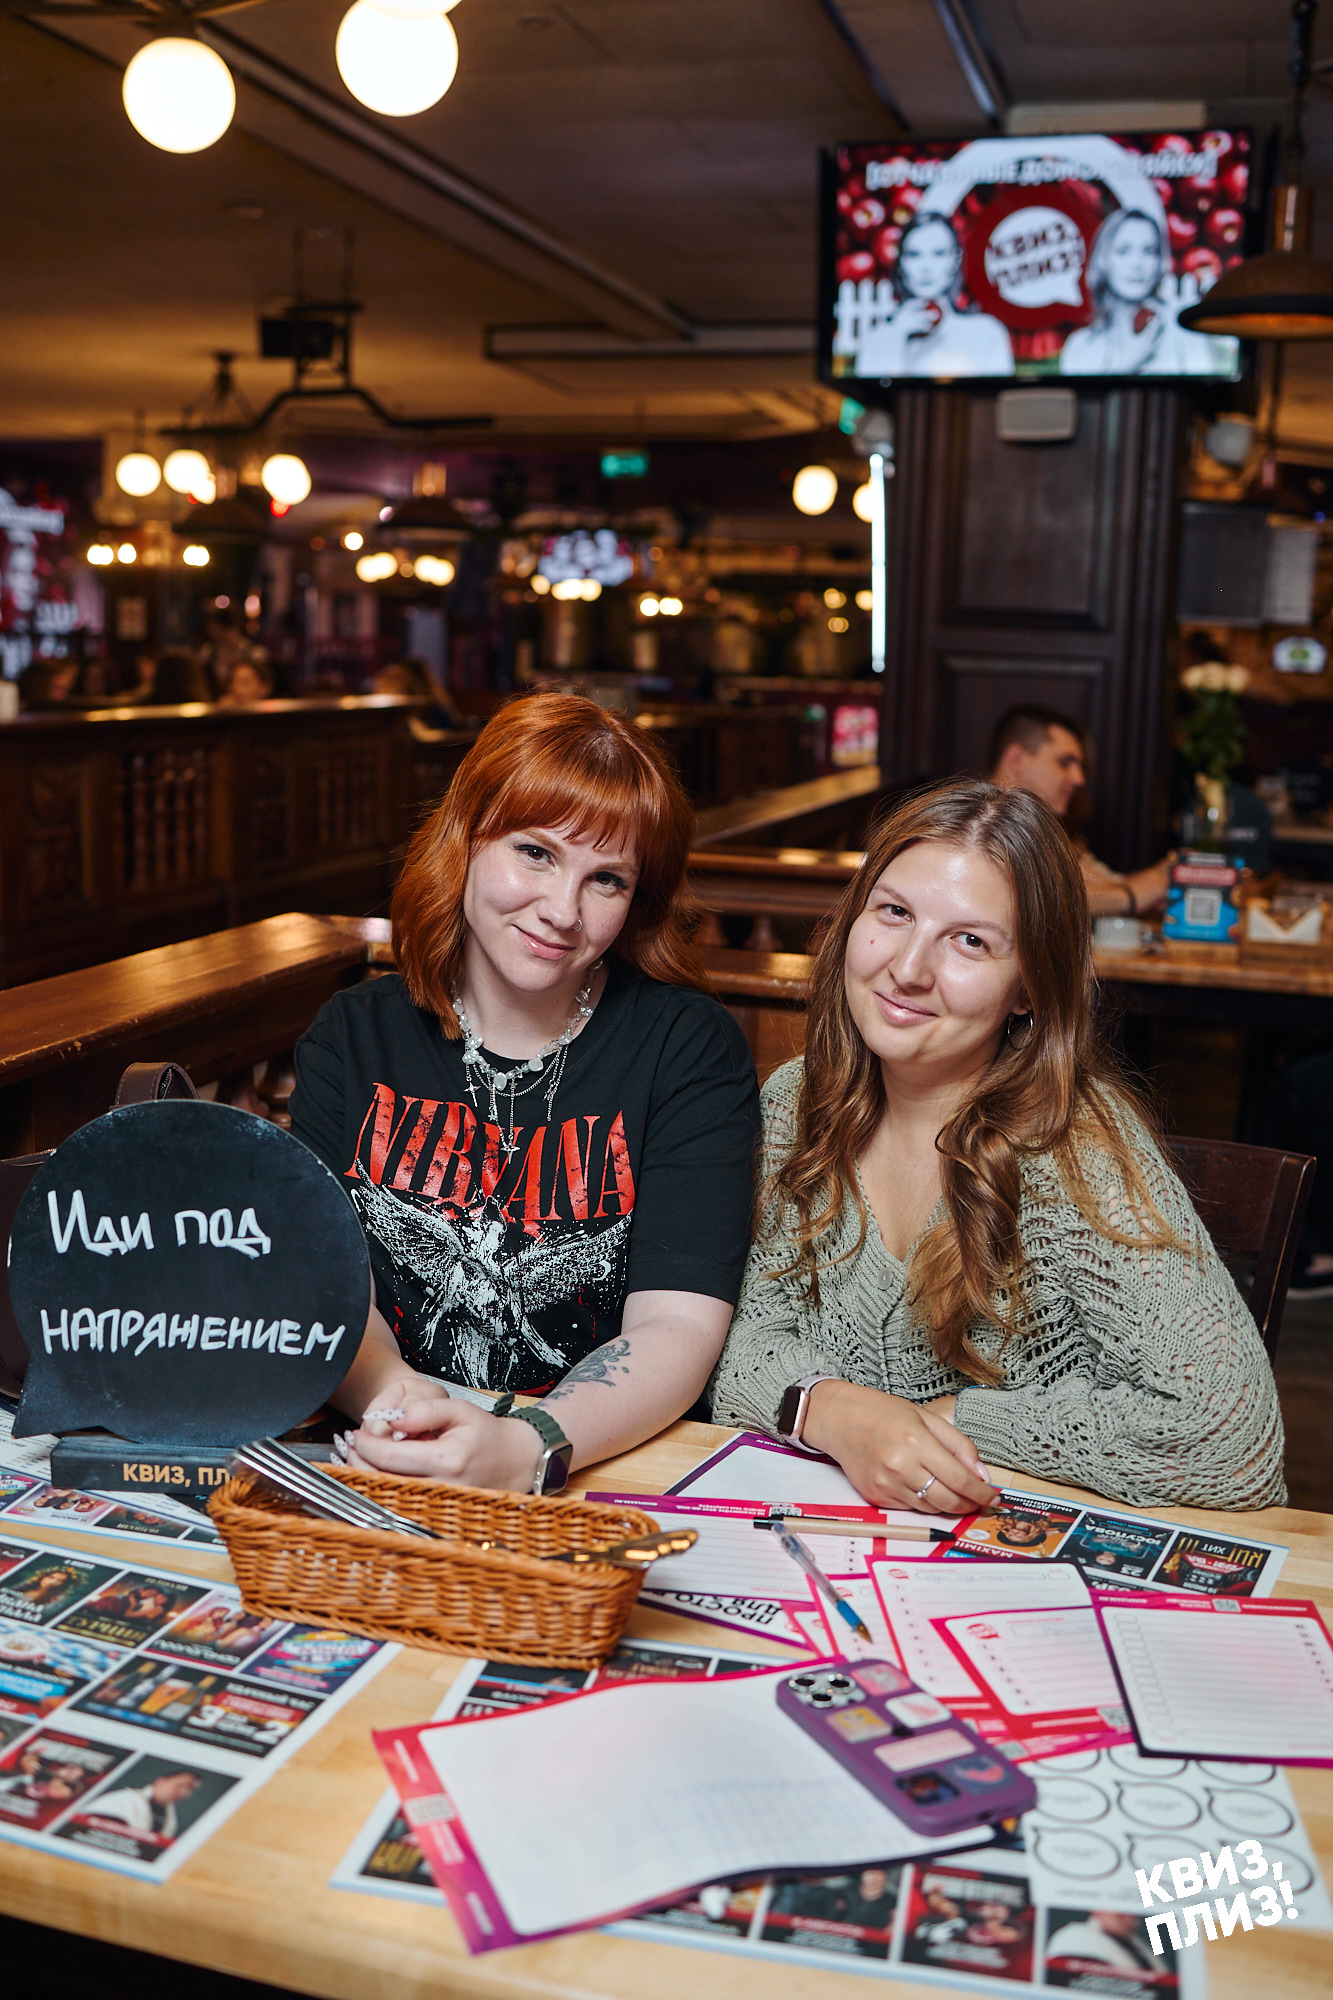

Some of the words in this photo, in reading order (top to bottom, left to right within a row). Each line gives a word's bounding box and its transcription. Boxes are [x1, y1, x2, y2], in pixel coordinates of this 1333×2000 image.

[344, 1082, 636, 1226] NIRVANA
[47, 1189, 156, 1258] Иди
[40, 1307, 346, 1363] НАПРЯЖЕНИЕМ
[123, 1463, 192, 1488] КВИЗ,
[198, 1467, 232, 1487] ПЛ
[1084, 1523, 1163, 1547] ЮСУПОВА
[1201, 1543, 1226, 1554] ХИТ
[675, 1592, 774, 1625] ПРОСТО
